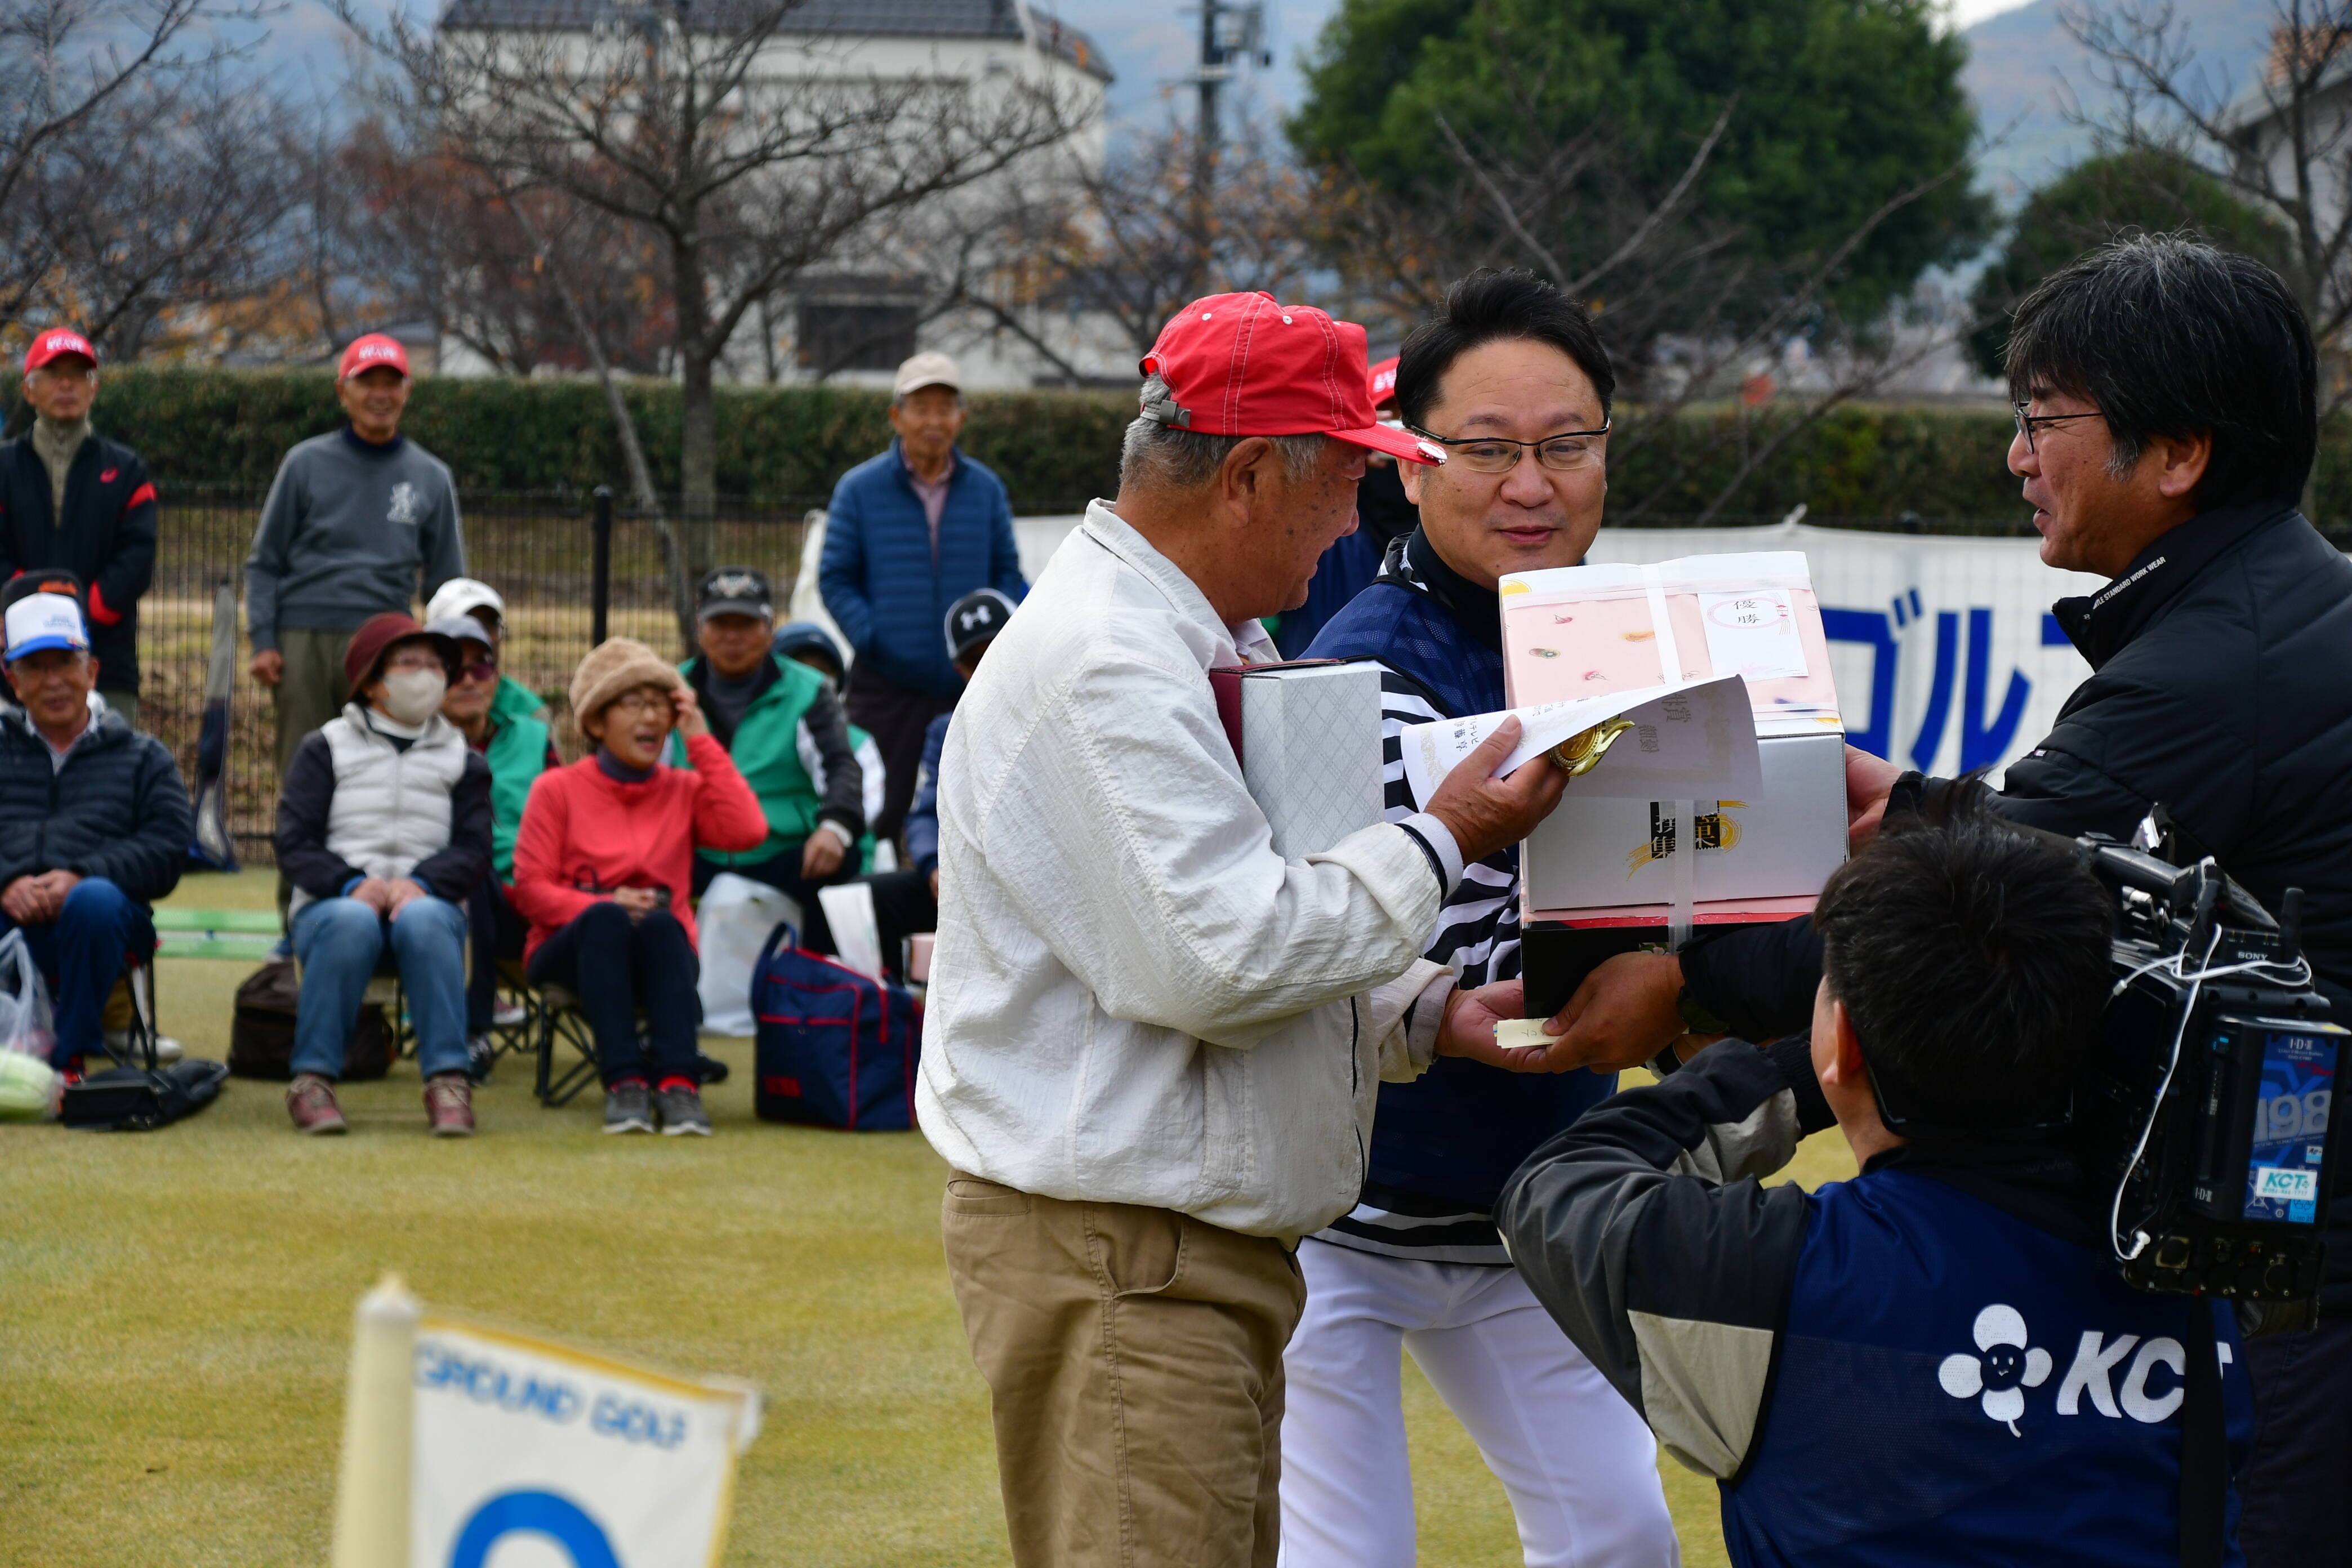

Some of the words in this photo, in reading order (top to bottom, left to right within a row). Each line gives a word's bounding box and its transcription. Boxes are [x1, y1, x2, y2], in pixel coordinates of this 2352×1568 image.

[2104, 579, 2131, 601] STANDARD
[2130, 567, 2149, 582] WORK
[2147, 556, 2166, 571] WEAR
[1734, 599, 1761, 625] 優勝
[2238, 951, 2268, 960] SONY
[2253, 1089, 2332, 1144] 198
[2265, 1172, 2308, 1190] KCT
[413, 1340, 586, 1426] GROUND
[589, 1390, 689, 1451] GOLF
